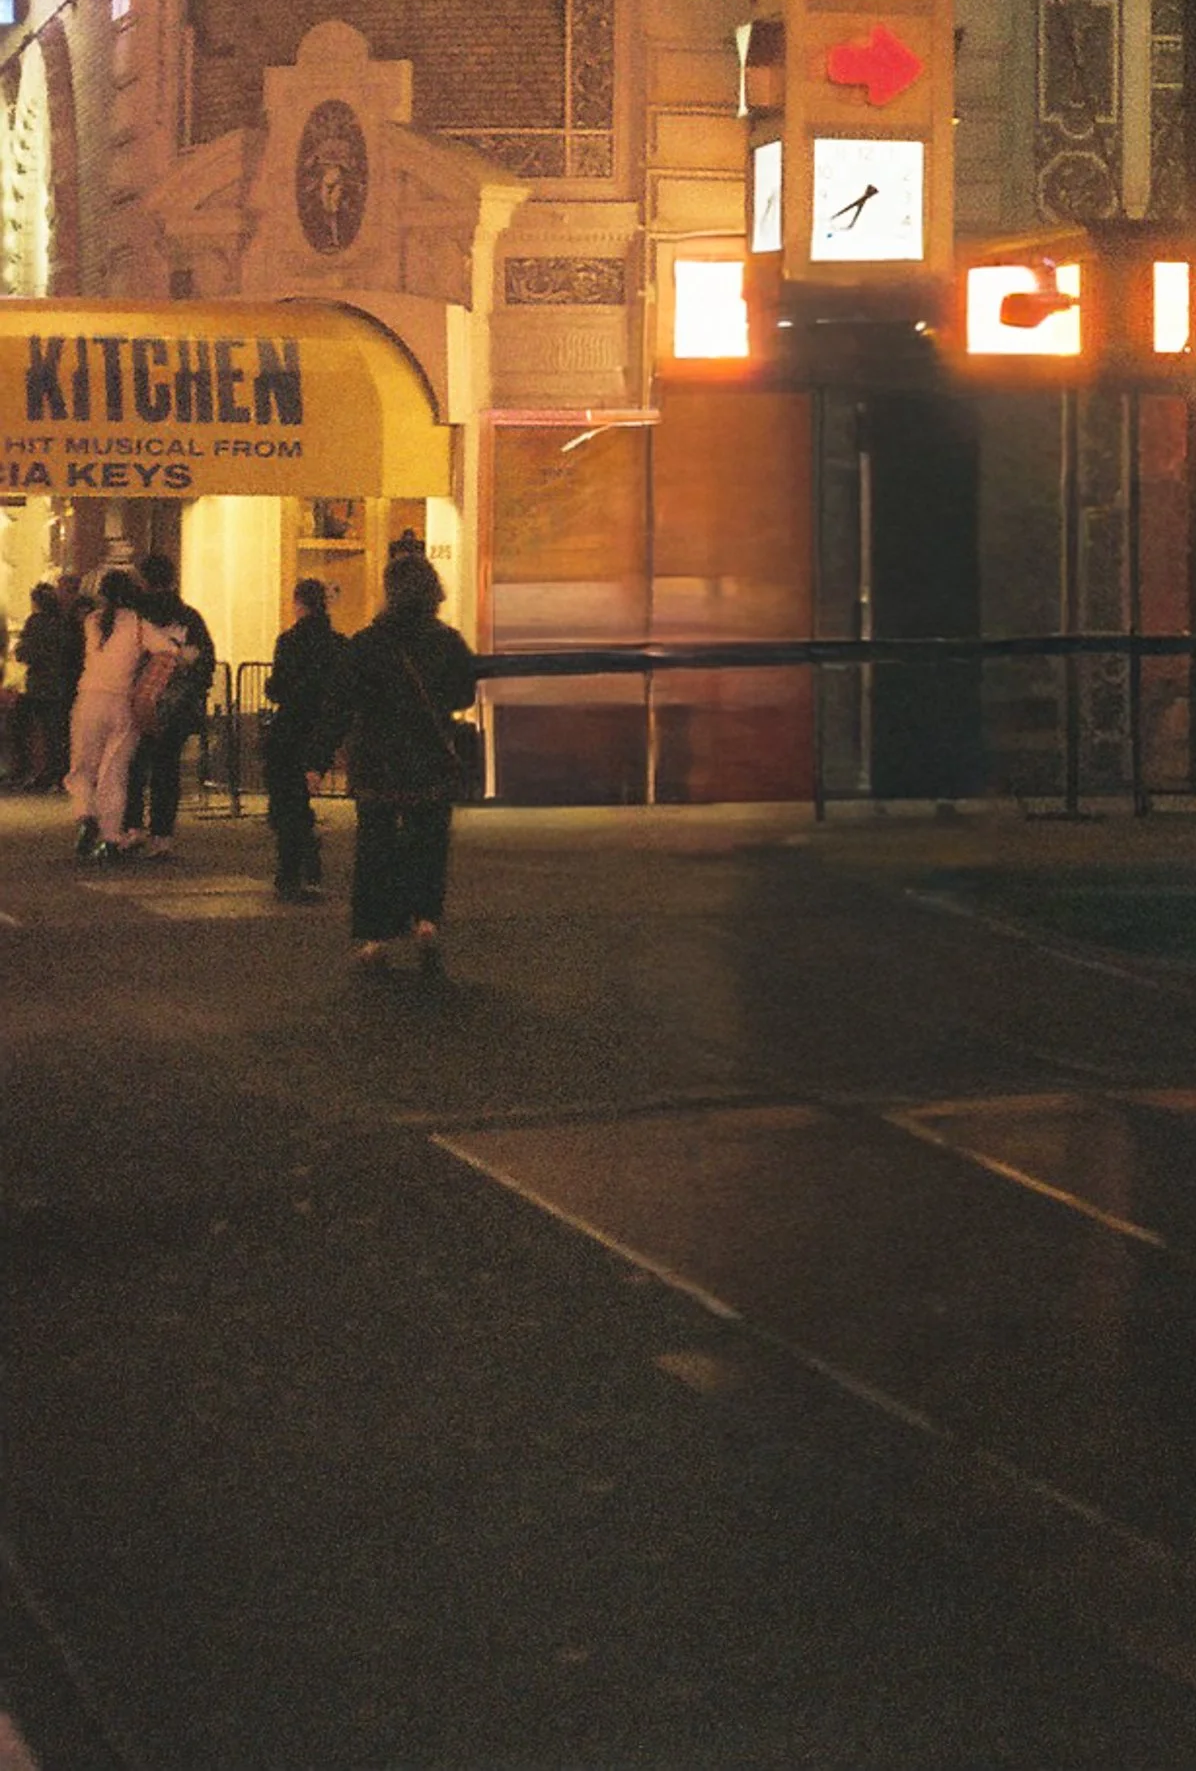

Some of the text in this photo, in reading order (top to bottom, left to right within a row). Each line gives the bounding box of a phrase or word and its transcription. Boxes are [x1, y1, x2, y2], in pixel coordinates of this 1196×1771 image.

[25, 335, 303, 426] KITCHEN
[5, 436, 303, 459] HIT MUSICAL FROM
[0, 461, 193, 489] IA KEYS
